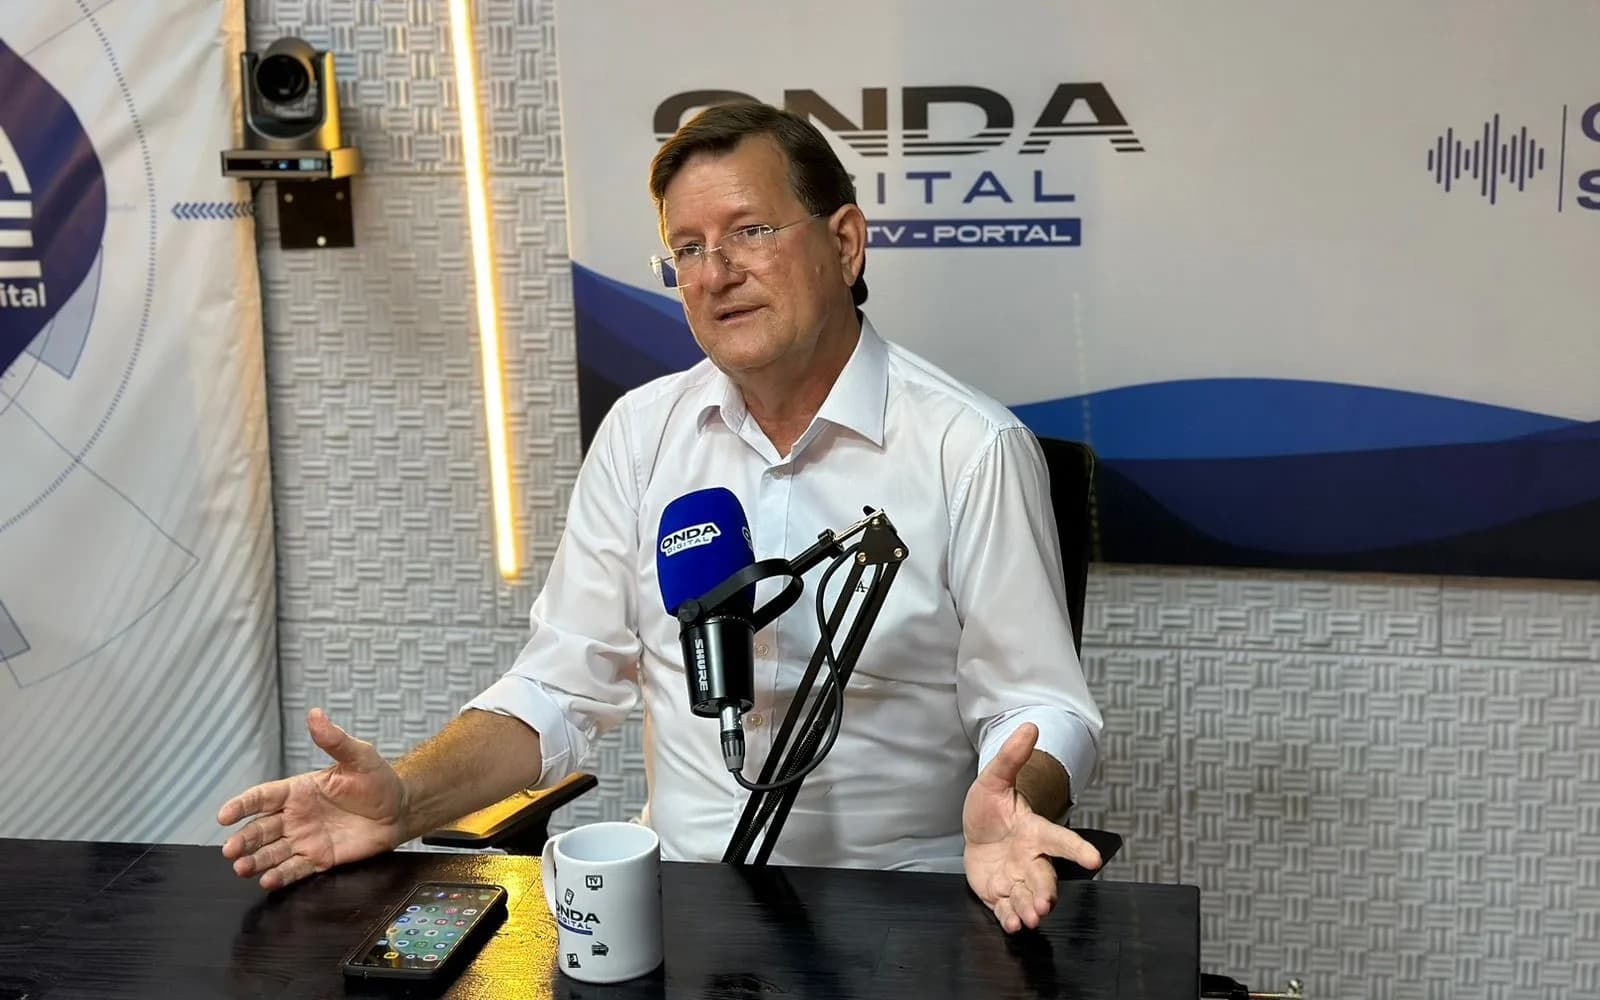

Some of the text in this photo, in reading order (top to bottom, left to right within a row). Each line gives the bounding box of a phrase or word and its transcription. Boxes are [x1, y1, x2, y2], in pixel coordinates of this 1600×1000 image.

[854, 170, 1076, 205] ITAL
[867, 226, 906, 243] TV
[934, 225, 1072, 243] PORTAL
[662, 524, 719, 550] ONDA
[667, 536, 710, 554] DIGITAL
[695, 638, 709, 692] SHURE
